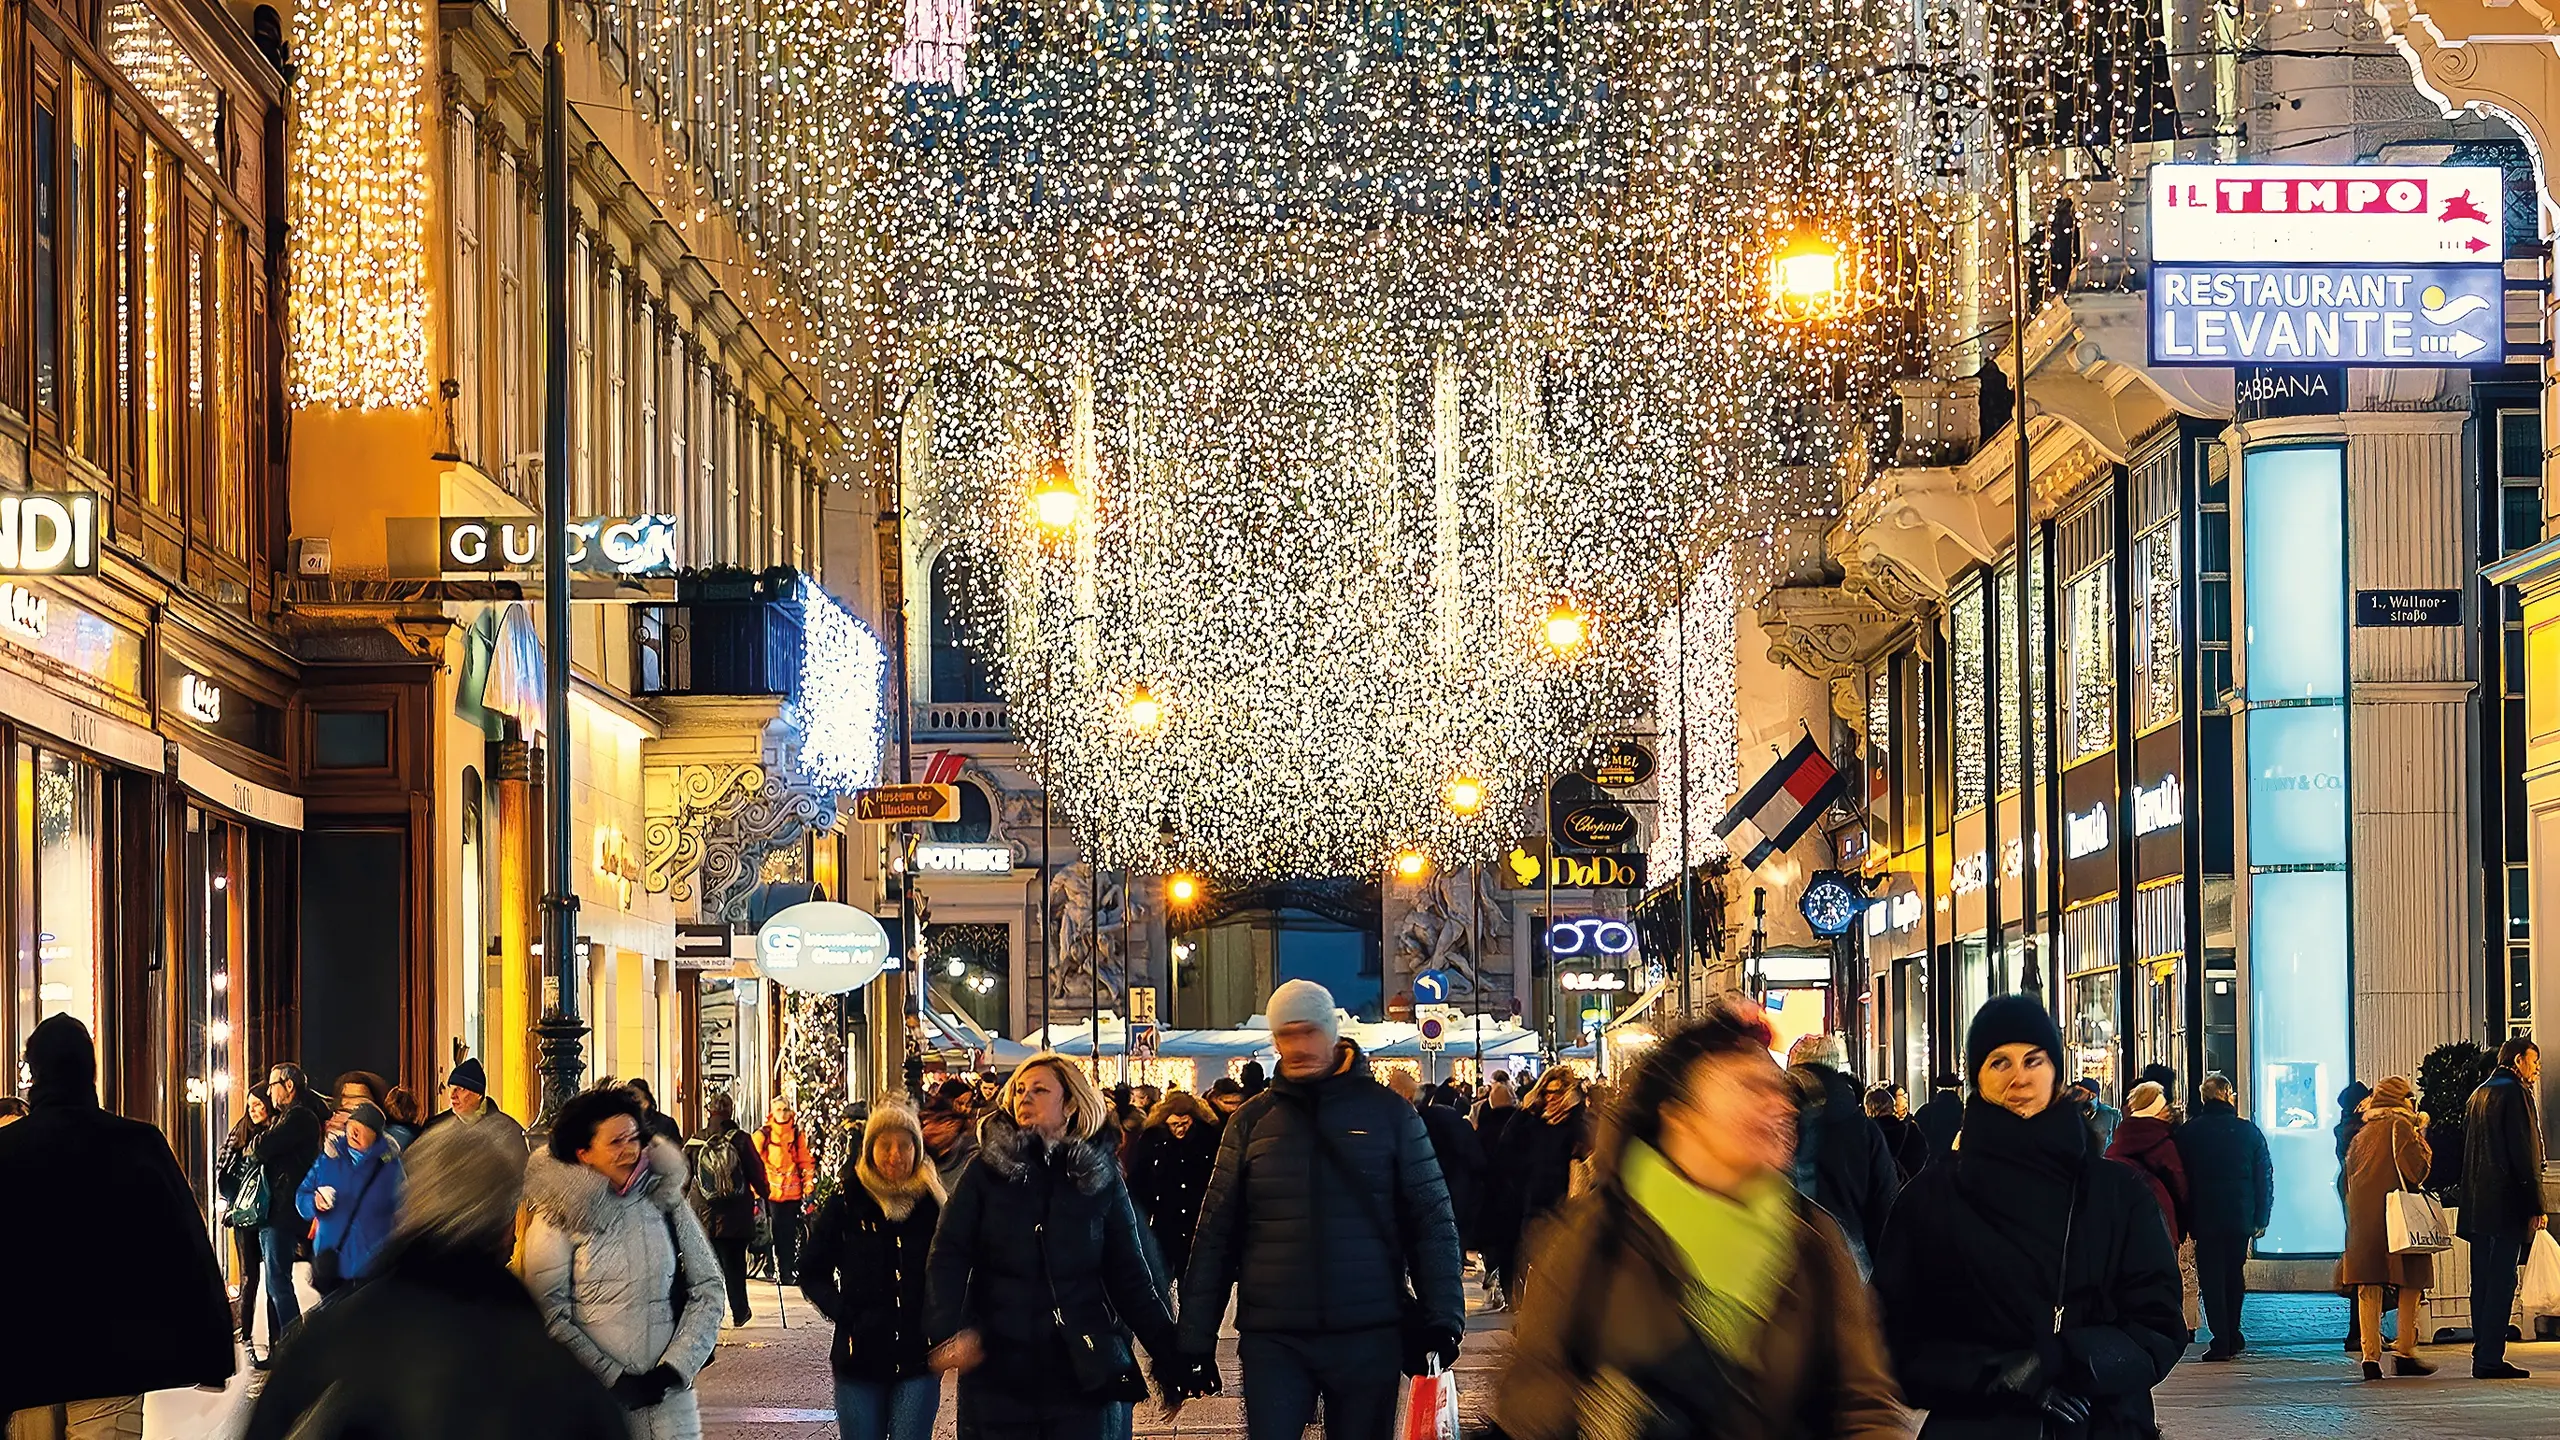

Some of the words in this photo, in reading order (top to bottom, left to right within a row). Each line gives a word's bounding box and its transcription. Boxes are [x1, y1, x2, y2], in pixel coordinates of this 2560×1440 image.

[2168, 185, 2207, 207] IL
[2220, 181, 2422, 212] TEMPO
[2164, 273, 2413, 307] RESTAURANT
[2164, 310, 2415, 357] LEVANTE
[2236, 374, 2329, 404] GABBANA
[894, 848, 1011, 872] POTHEKE
[1552, 856, 1636, 887] DoDo
